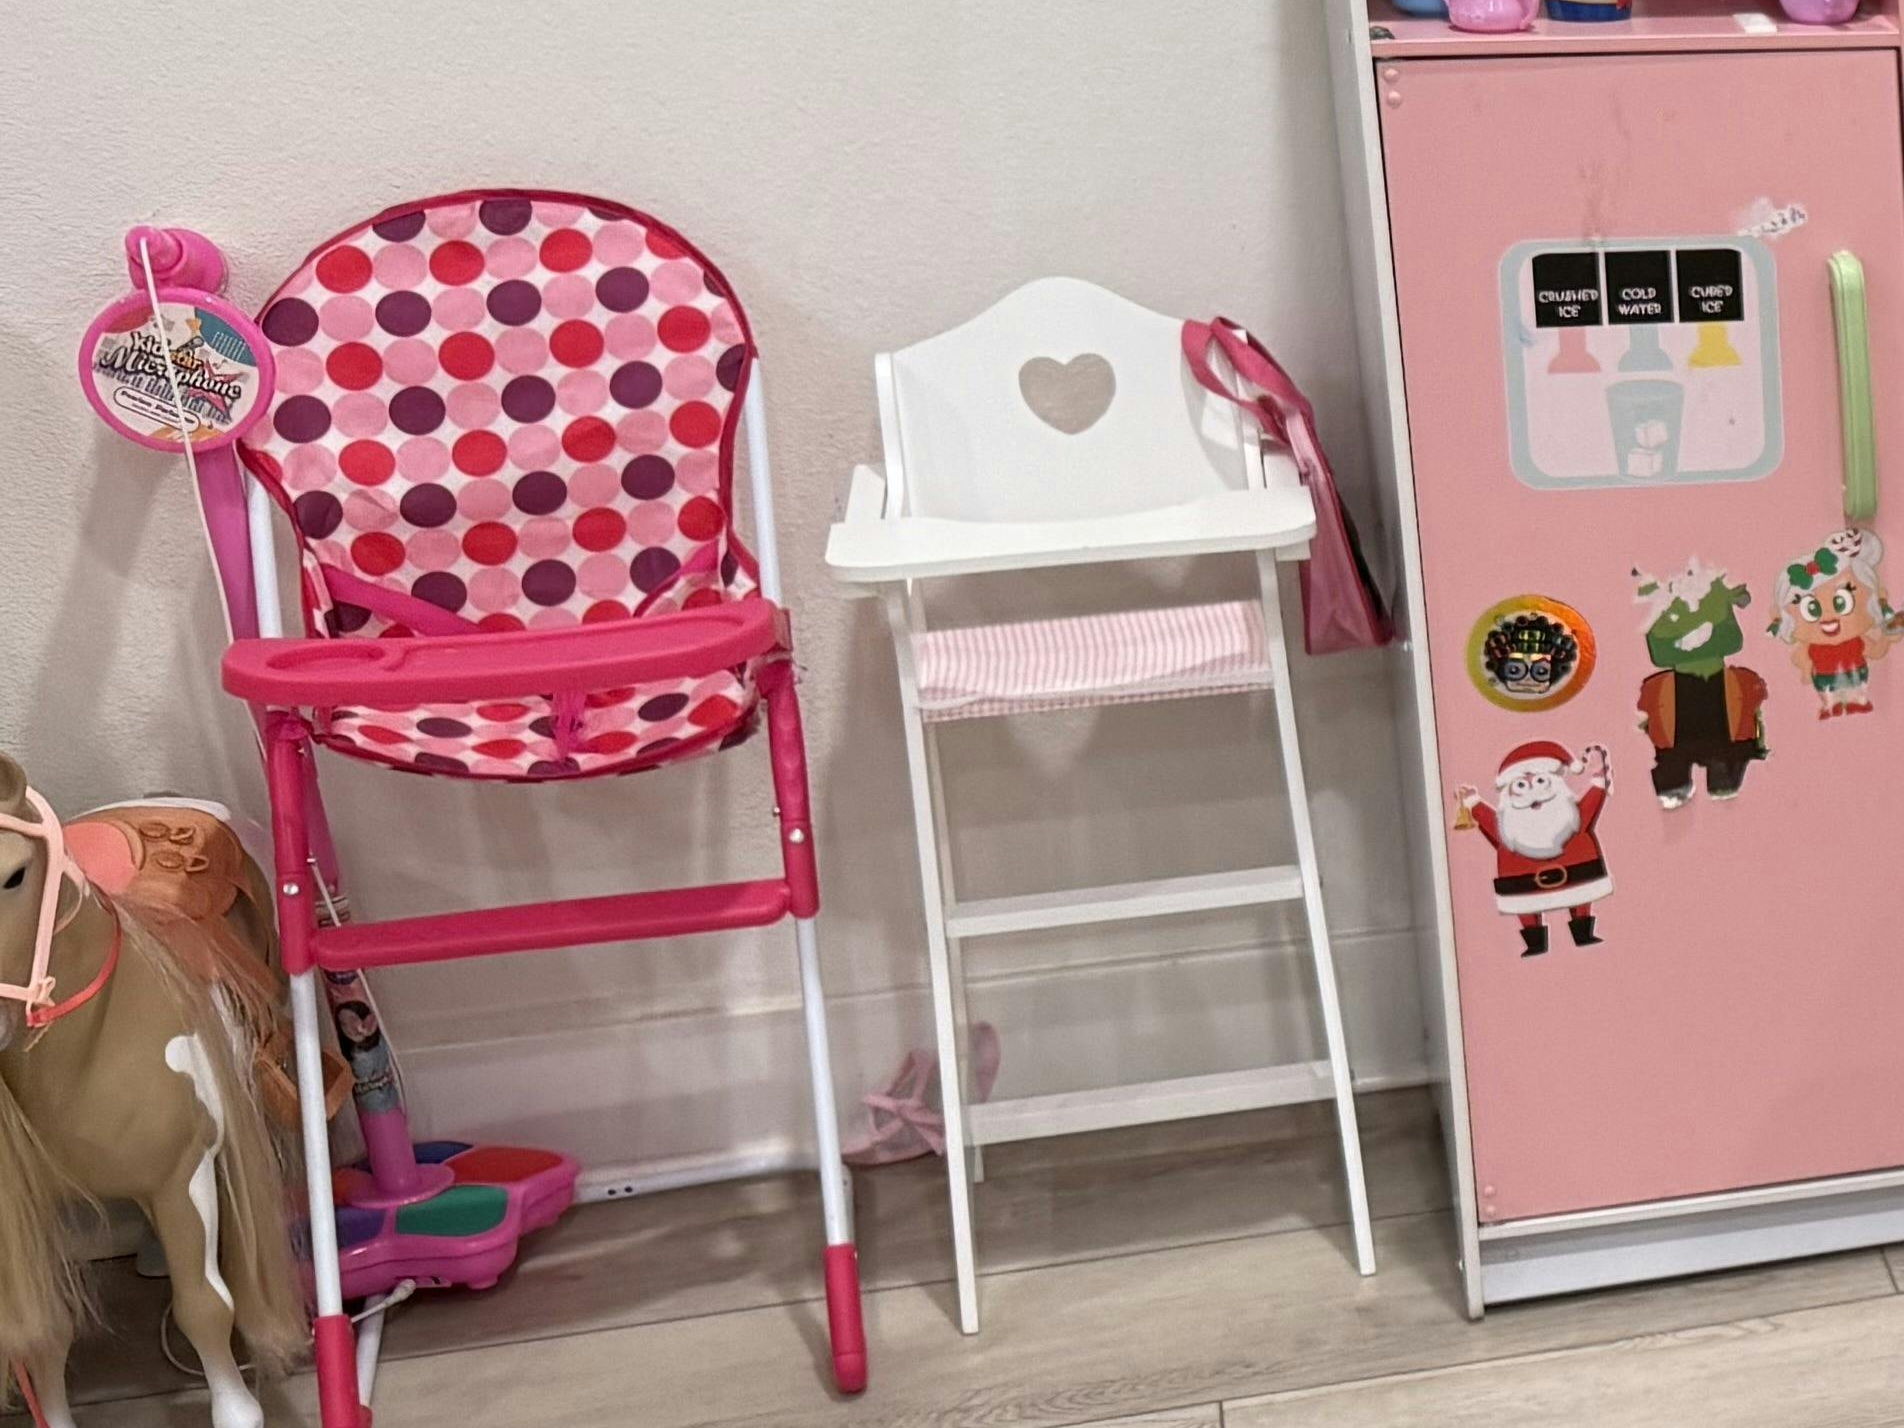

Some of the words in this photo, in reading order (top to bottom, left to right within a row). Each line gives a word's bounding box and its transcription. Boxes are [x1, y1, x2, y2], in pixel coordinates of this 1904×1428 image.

[1539, 288, 1599, 303] CRUSHED
[1621, 287, 1656, 300] COLD
[1690, 285, 1733, 298] CUBED
[1558, 305, 1581, 318] ICE
[1618, 302, 1661, 315] WATER
[1701, 300, 1723, 313] ICE
